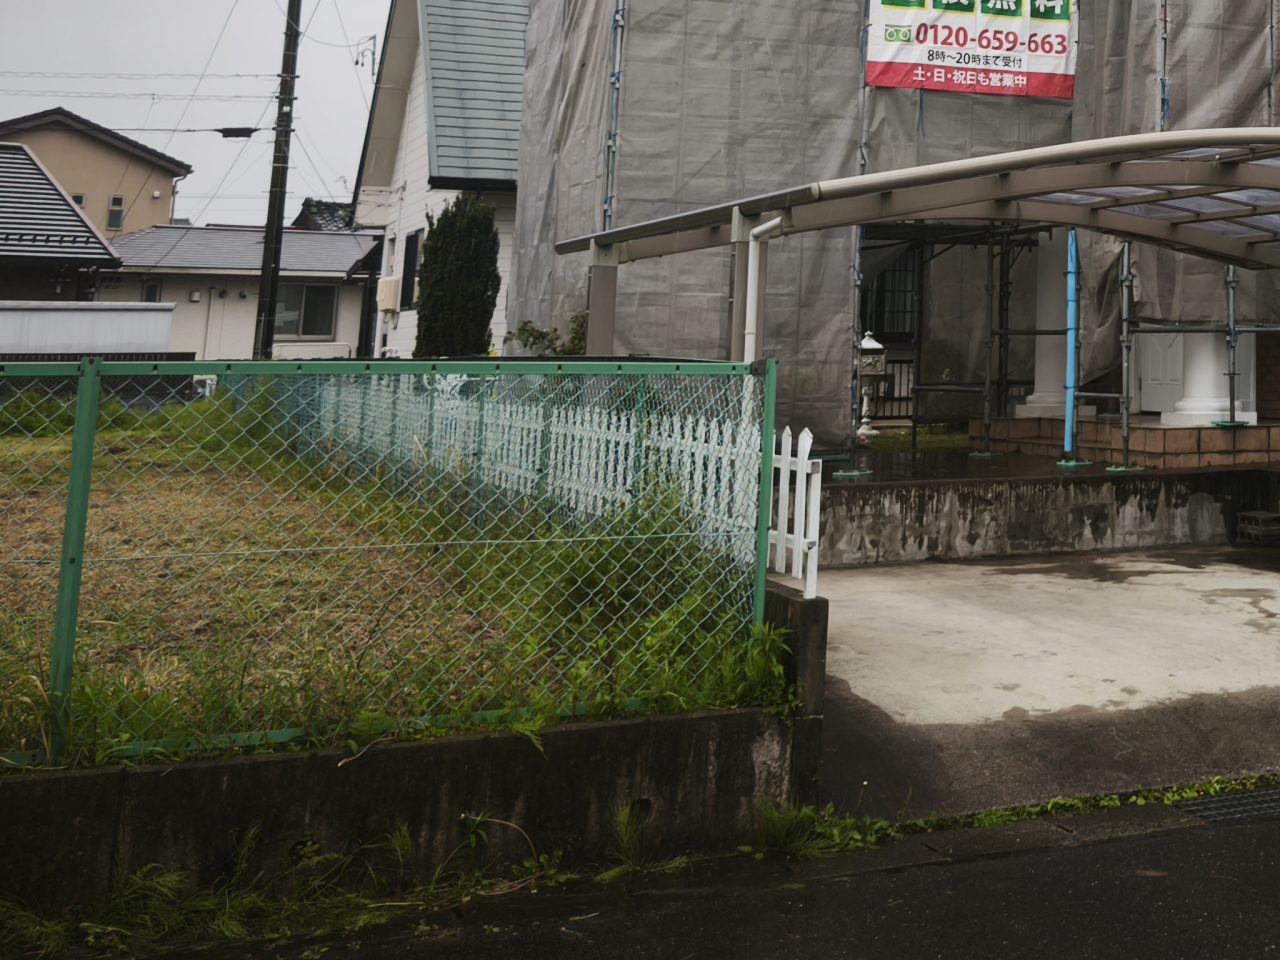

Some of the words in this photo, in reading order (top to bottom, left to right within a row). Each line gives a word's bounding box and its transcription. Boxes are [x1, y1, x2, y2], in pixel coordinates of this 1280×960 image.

[915, 23, 1068, 55] 0120-659-663
[912, 66, 1027, 87] 土・日・祝日も営業中
